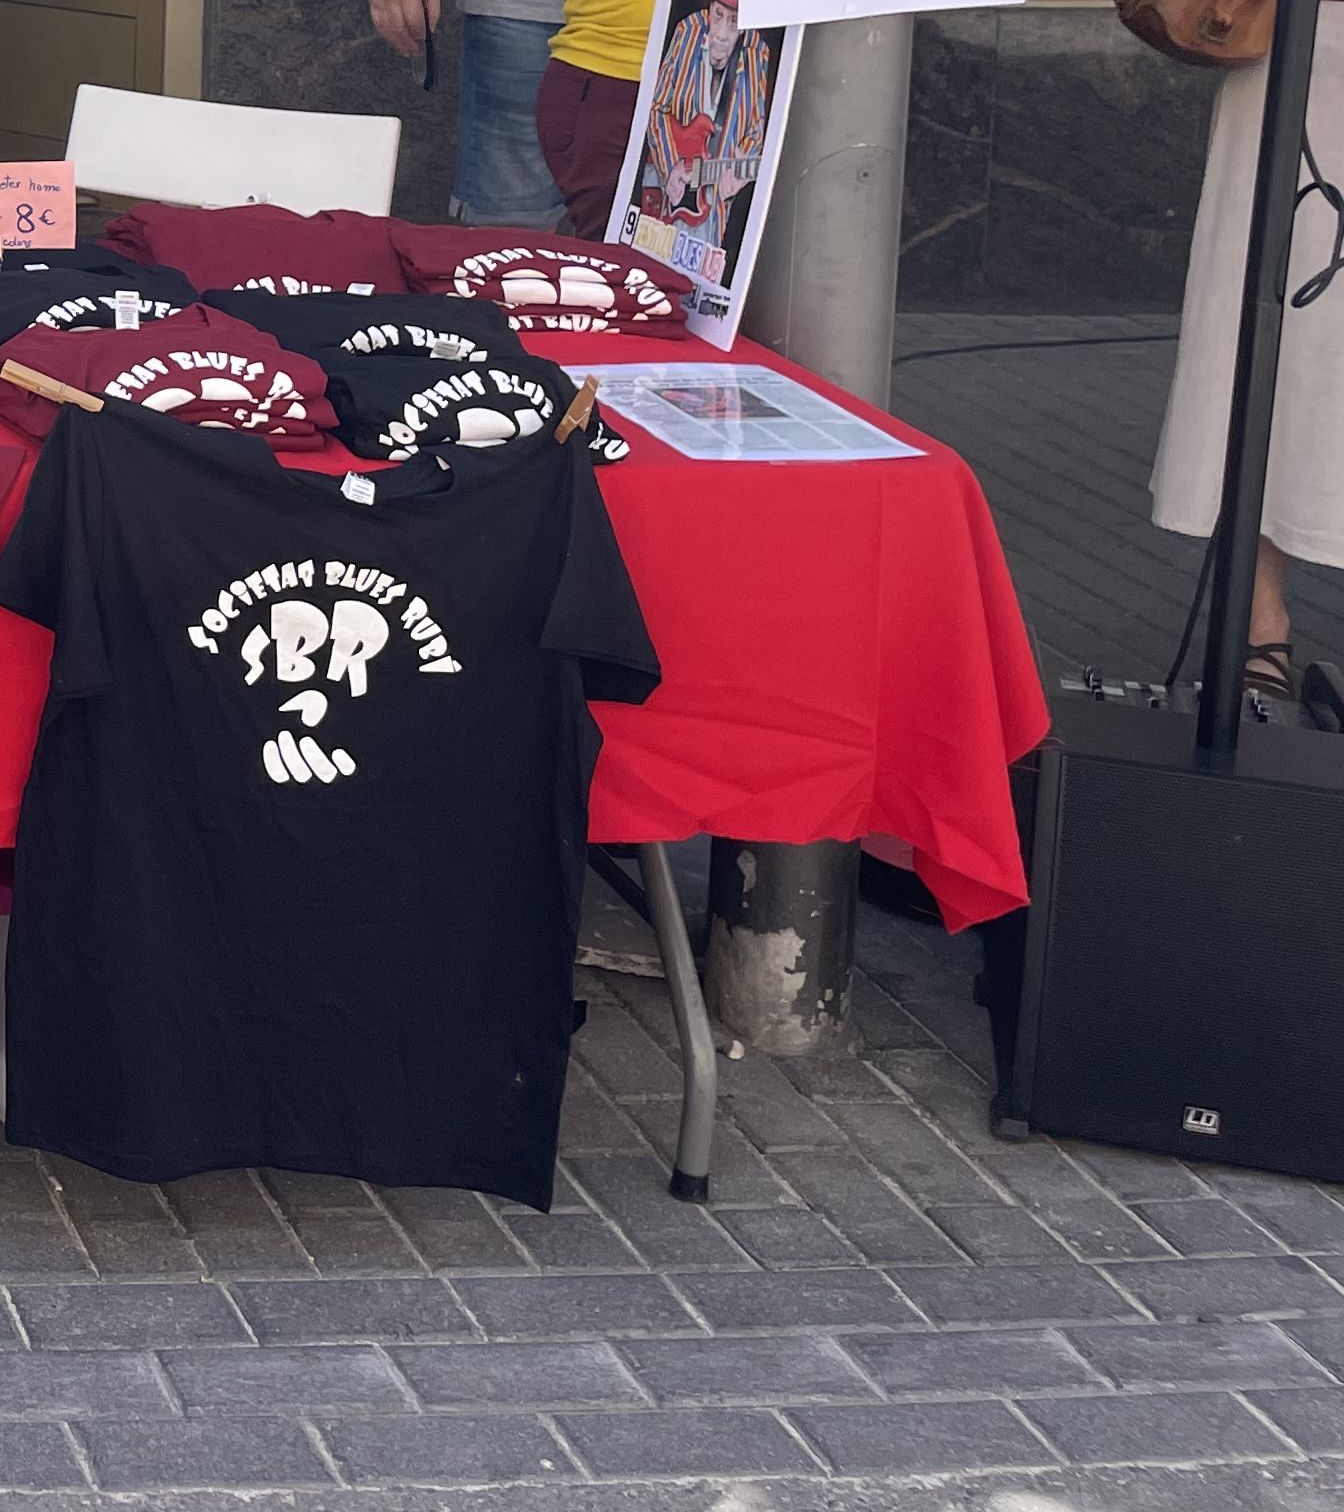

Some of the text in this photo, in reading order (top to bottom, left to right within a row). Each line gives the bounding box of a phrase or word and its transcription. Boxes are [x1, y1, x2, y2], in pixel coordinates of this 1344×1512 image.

[625, 210, 637, 236] 9
[168, 350, 265, 382] BLUES
[324, 560, 407, 605] BLUES
[240, 599, 390, 698] SBR
